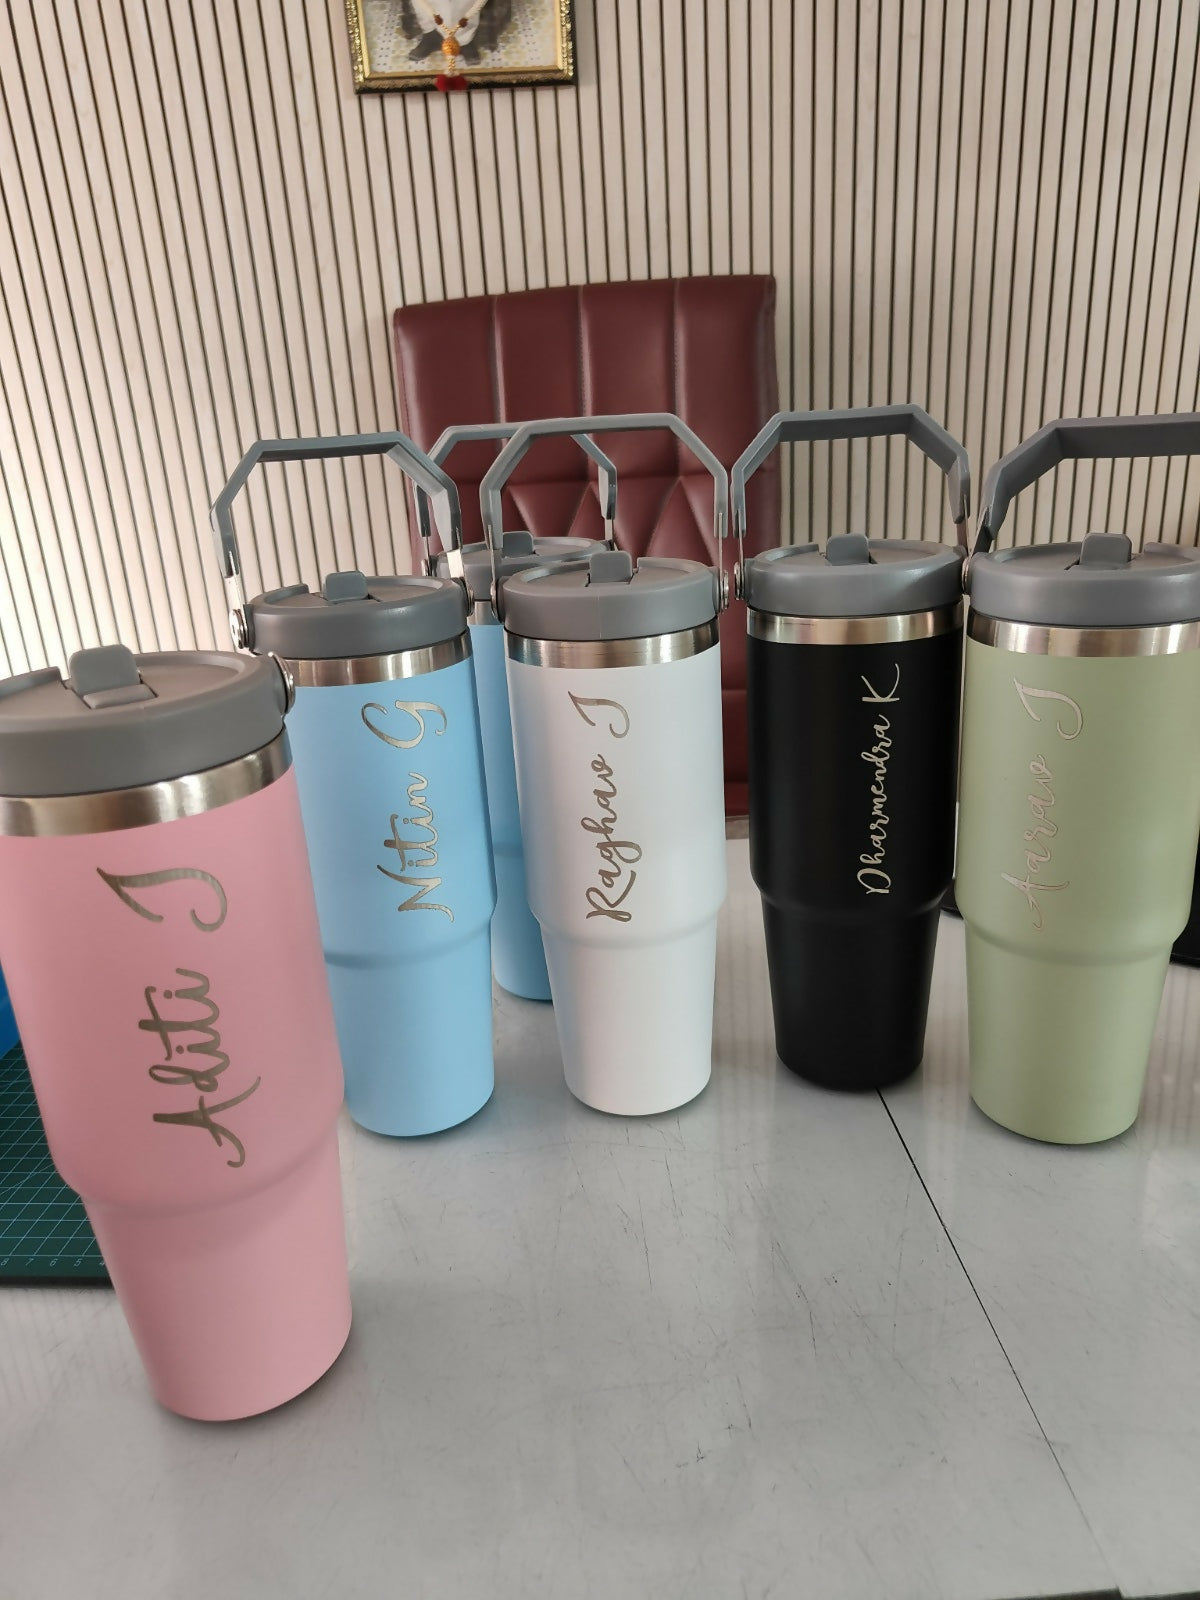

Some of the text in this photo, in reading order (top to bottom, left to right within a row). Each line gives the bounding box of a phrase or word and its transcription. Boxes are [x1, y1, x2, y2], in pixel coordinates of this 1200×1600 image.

[361, 700, 455, 923] Nitin G
[580, 753, 643, 923] Raghav
[856, 663, 900, 894] Dharmendra K
[1001, 754, 1070, 929] Aarav
[137, 967, 262, 1168] Aditi
[25, 1257, 34, 1266] 7
[49, 1257, 59, 1267] 6
